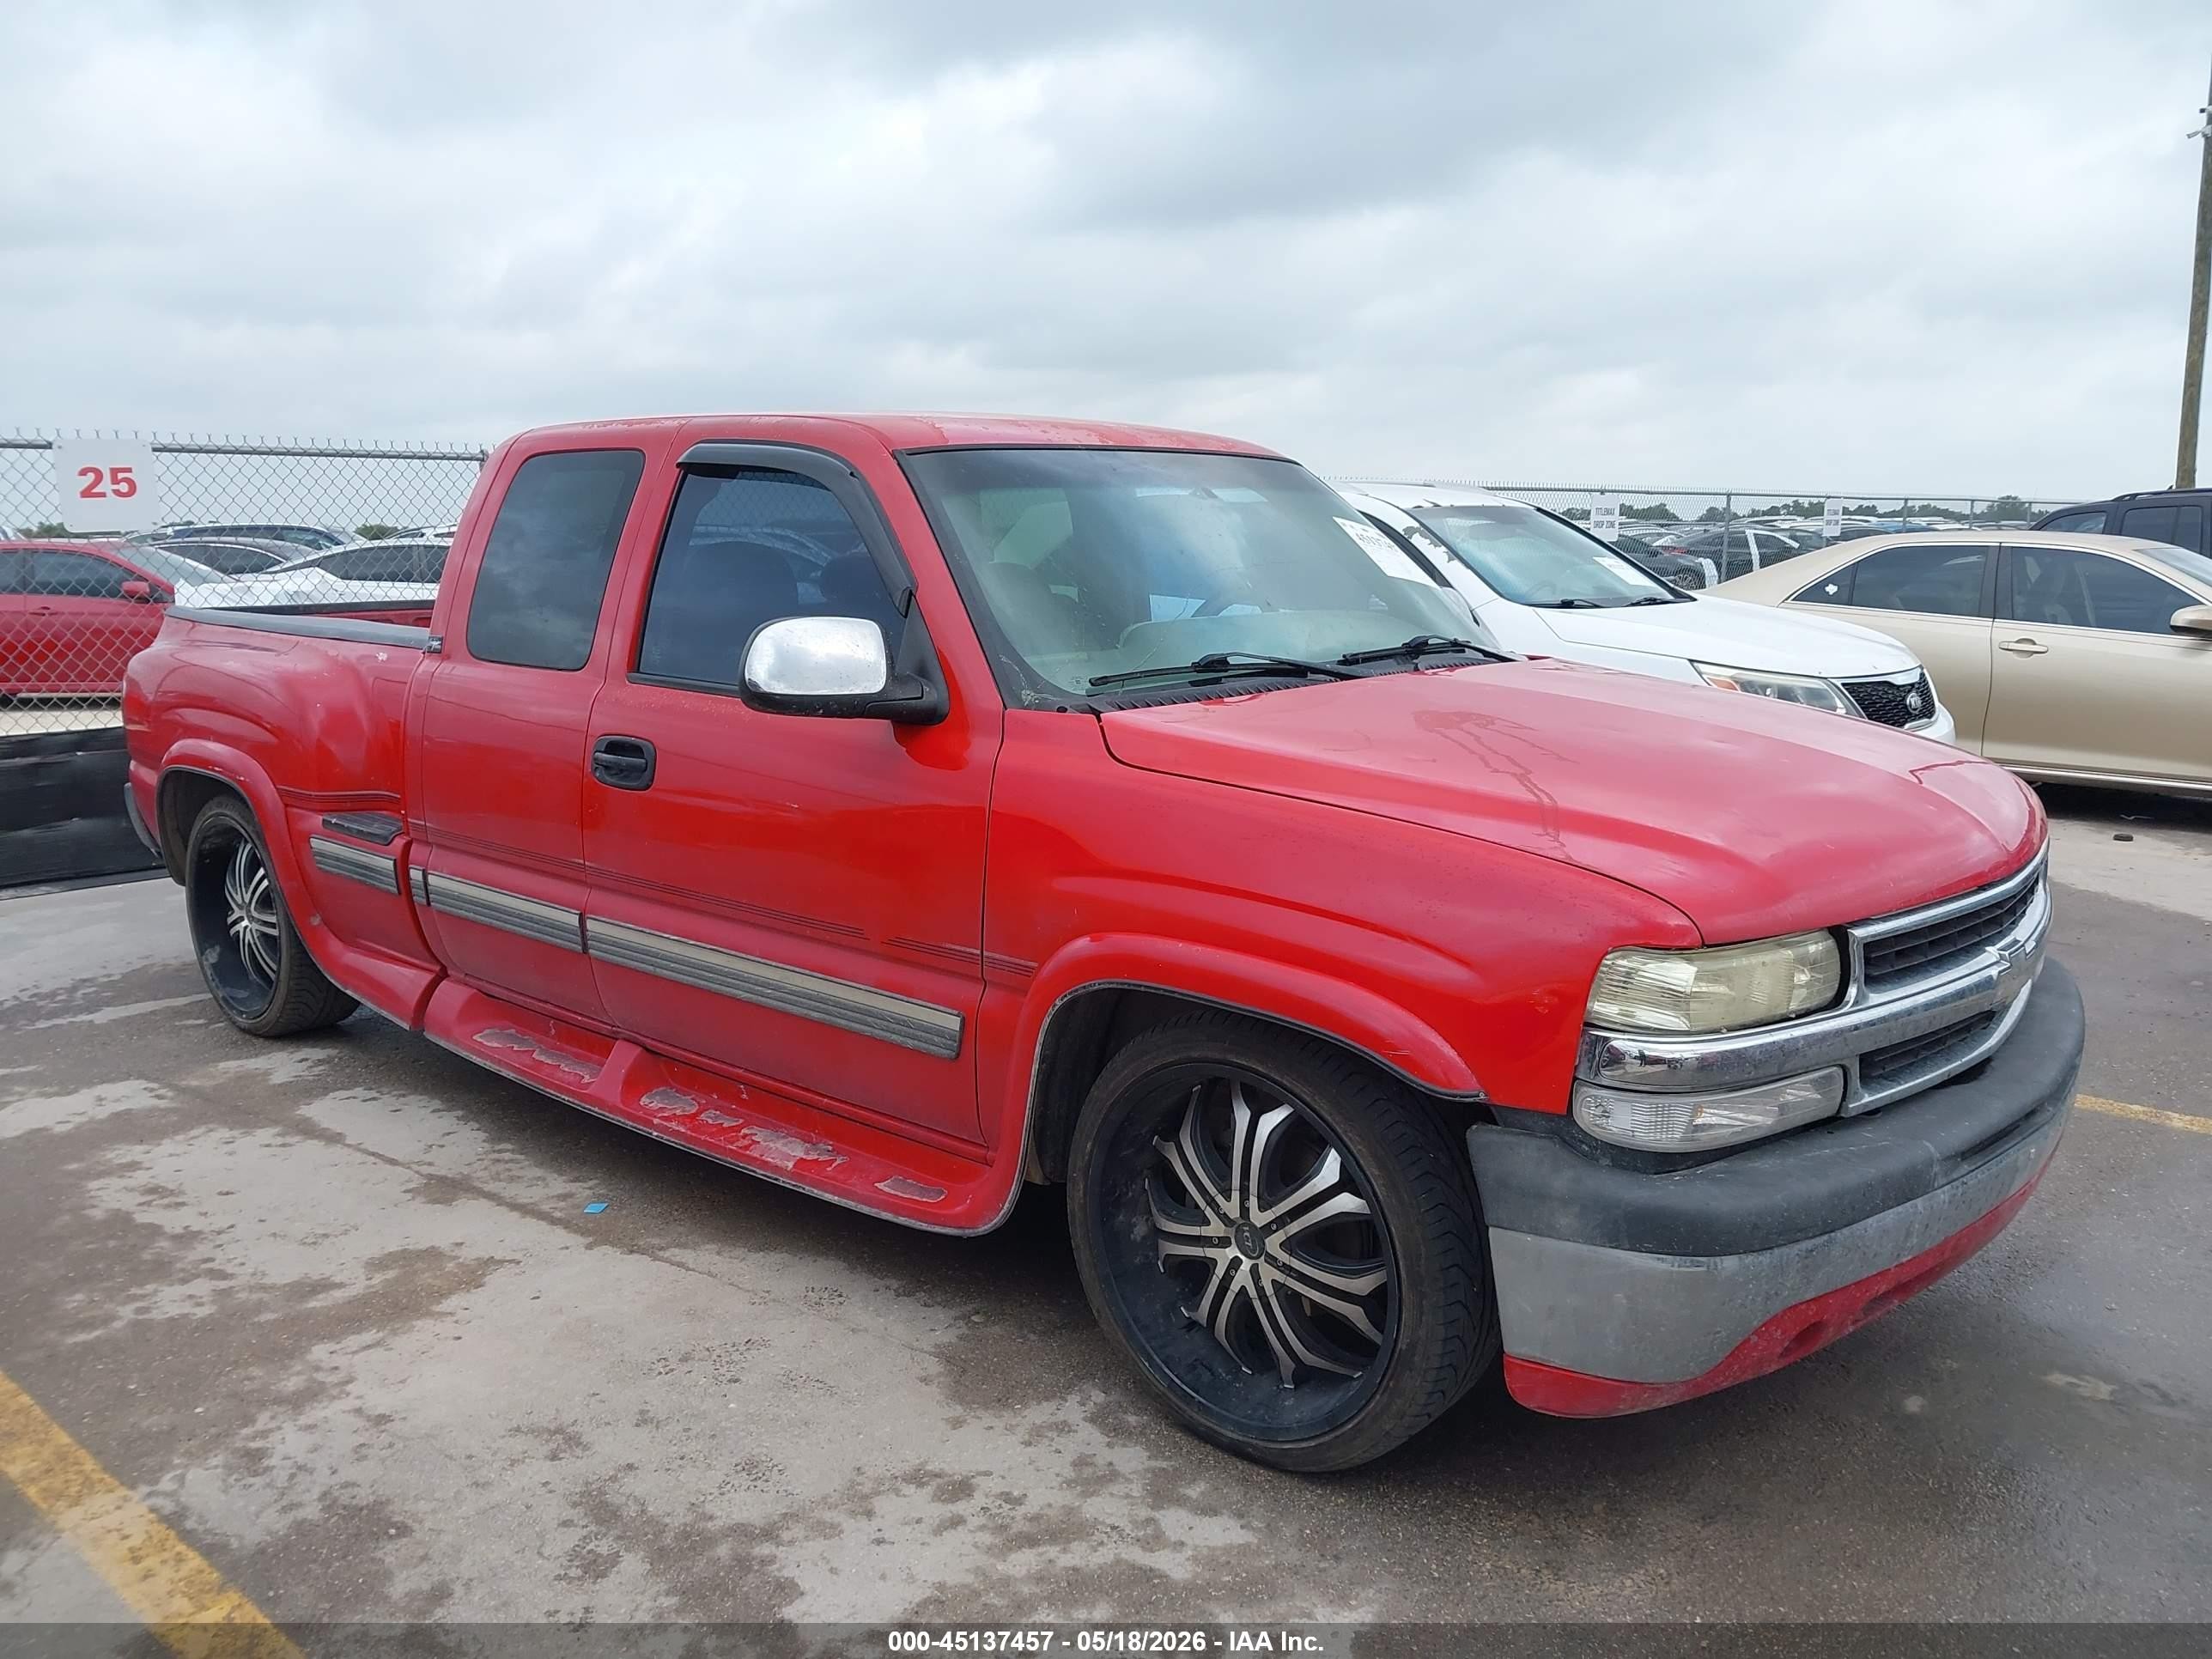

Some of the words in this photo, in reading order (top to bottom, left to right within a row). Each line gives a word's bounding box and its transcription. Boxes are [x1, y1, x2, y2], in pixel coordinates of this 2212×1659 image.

[78, 466, 137, 499] 25
[1593, 520, 1604, 529] DROP
[1605, 520, 1616, 529] ZONE
